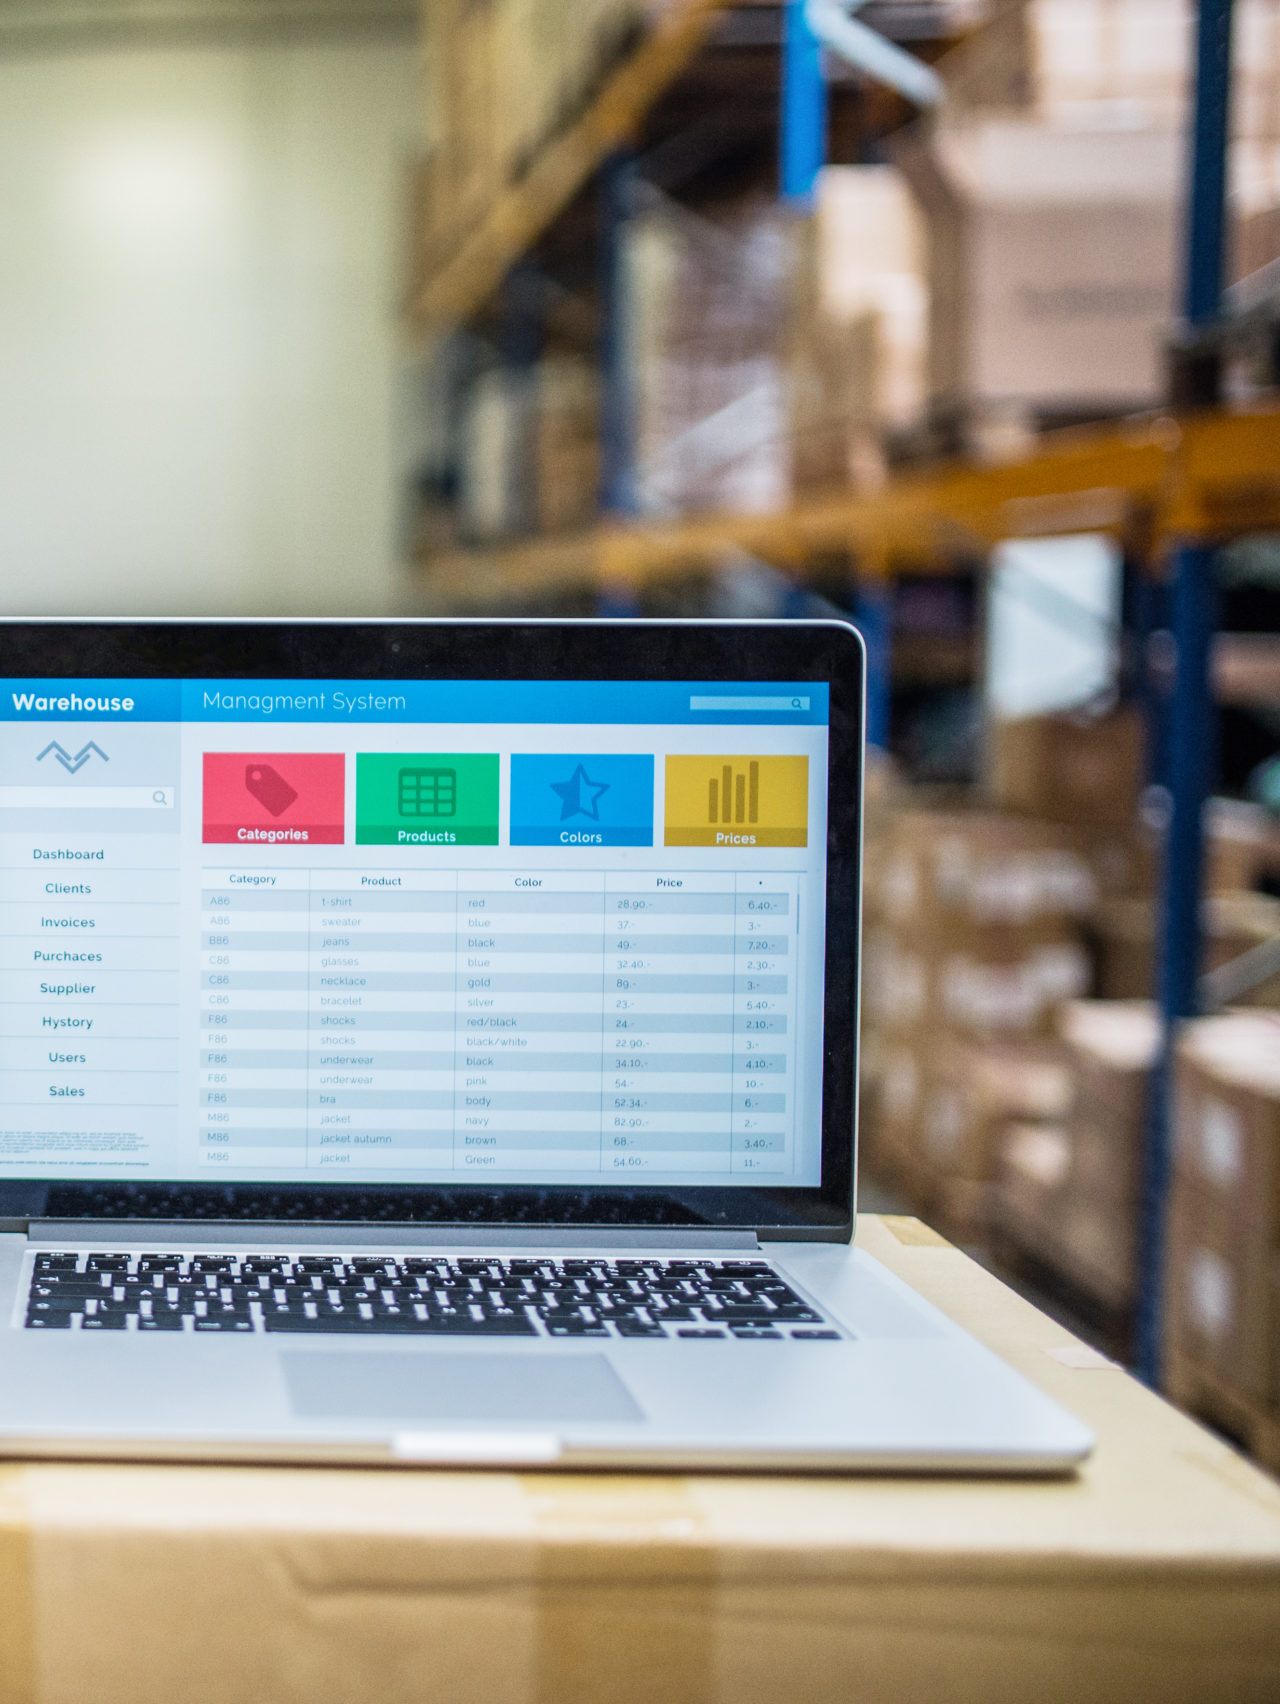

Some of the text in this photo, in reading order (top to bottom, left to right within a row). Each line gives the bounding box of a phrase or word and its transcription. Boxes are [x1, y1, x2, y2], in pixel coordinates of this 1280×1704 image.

[12, 693, 135, 712] Warehouse
[203, 691, 407, 713] Managment System
[237, 827, 309, 843] Categories
[397, 830, 457, 843] Products
[559, 831, 603, 844] Colors
[715, 832, 756, 845] Prices
[32, 848, 105, 861] Dashboard
[229, 874, 683, 888] Category Product Color Price
[45, 882, 92, 895] Clients
[210, 896, 230, 906] A86
[321, 897, 353, 907] t-shirt
[468, 898, 485, 908] red
[40, 916, 96, 928] Invoices
[210, 916, 230, 926] A86
[321, 917, 362, 927] sweater
[467, 918, 491, 928] blue
[209, 936, 229, 946] B86
[321, 936, 350, 948] jeans
[467, 938, 495, 948] black
[33, 950, 103, 962] Purchaces
[209, 955, 230, 965] C86
[321, 956, 359, 967] glasses
[467, 958, 490, 967] blue
[208, 975, 230, 985] C86
[320, 976, 367, 986] necklace
[467, 977, 491, 988] gold
[40, 982, 96, 996] Supplier
[208, 995, 230, 1005] C86
[320, 996, 362, 1006] bracelet
[467, 997, 494, 1007] silver
[41, 1016, 93, 1030] Hystory
[208, 1014, 228, 1024] F86
[320, 1015, 356, 1025] shocks
[466, 1017, 517, 1027] red/black
[208, 1034, 228, 1044] F86
[320, 1035, 356, 1045] shocks
[466, 1036, 528, 1047] black/white
[48, 1052, 87, 1063] Users
[208, 1053, 228, 1064] F86
[320, 1055, 374, 1065] underwear
[466, 1056, 494, 1066] black
[207, 1073, 228, 1084] F86
[320, 1075, 374, 1085] underwear
[465, 1076, 487, 1087] pink
[49, 1085, 86, 1097] Sales
[207, 1093, 227, 1103] F86
[319, 1094, 336, 1104] bra
[465, 1095, 492, 1107] body
[207, 1112, 230, 1122] M86
[319, 1113, 351, 1125] jacket
[465, 1116, 489, 1127] navy
[207, 1132, 230, 1142] M86
[319, 1133, 351, 1145] jacket
[353, 1135, 392, 1144] autumn
[465, 1135, 497, 1145] brown
[207, 1151, 230, 1162] M86
[319, 1153, 351, 1164] jacket
[465, 1155, 496, 1165] Green
